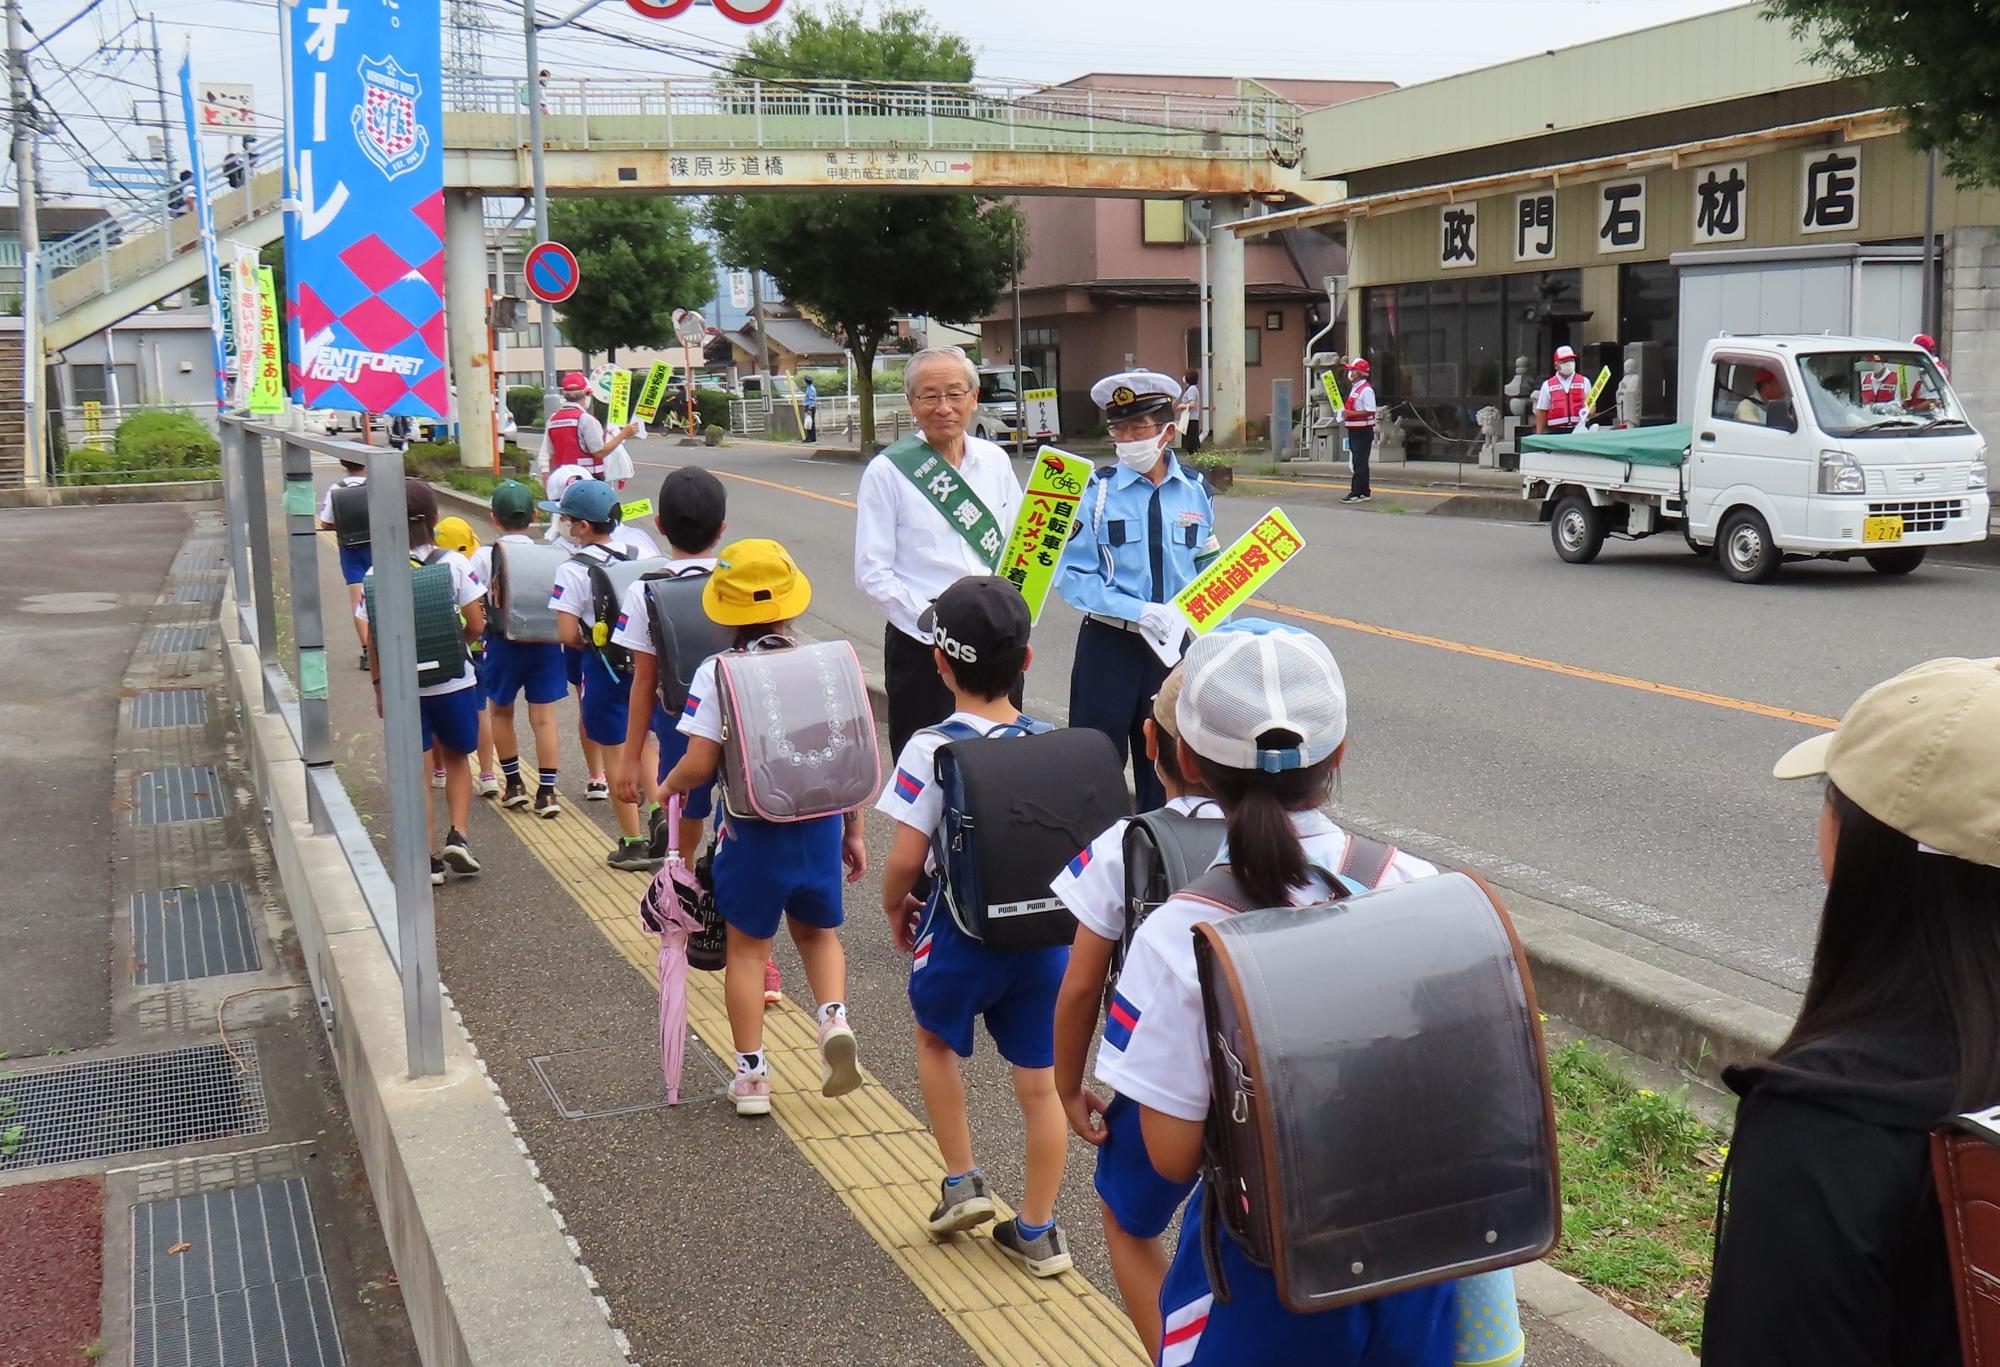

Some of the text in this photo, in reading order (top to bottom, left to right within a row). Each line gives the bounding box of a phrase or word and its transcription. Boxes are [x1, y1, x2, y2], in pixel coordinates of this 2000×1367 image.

[670, 156, 947, 177] 篠原歩道橋 入口
[825, 152, 920, 165] 竜王小学校
[827, 167, 920, 181] 甲斐市竜王武道館
[1442, 153, 1857, 262] 政門石材店
[260, 304, 280, 397] 歩行者あり
[300, 326, 424, 378] VENTFORET
[310, 363, 361, 384] KOFU
[913, 456, 938, 479] 甲斐市
[1037, 502, 1073, 567] 自転車も
[1256, 519, 1296, 560] 根絶
[1185, 544, 1270, 623] 飲酒運転
[998, 906, 1017, 914] PUMA
[1027, 902, 1045, 910] PUMA
